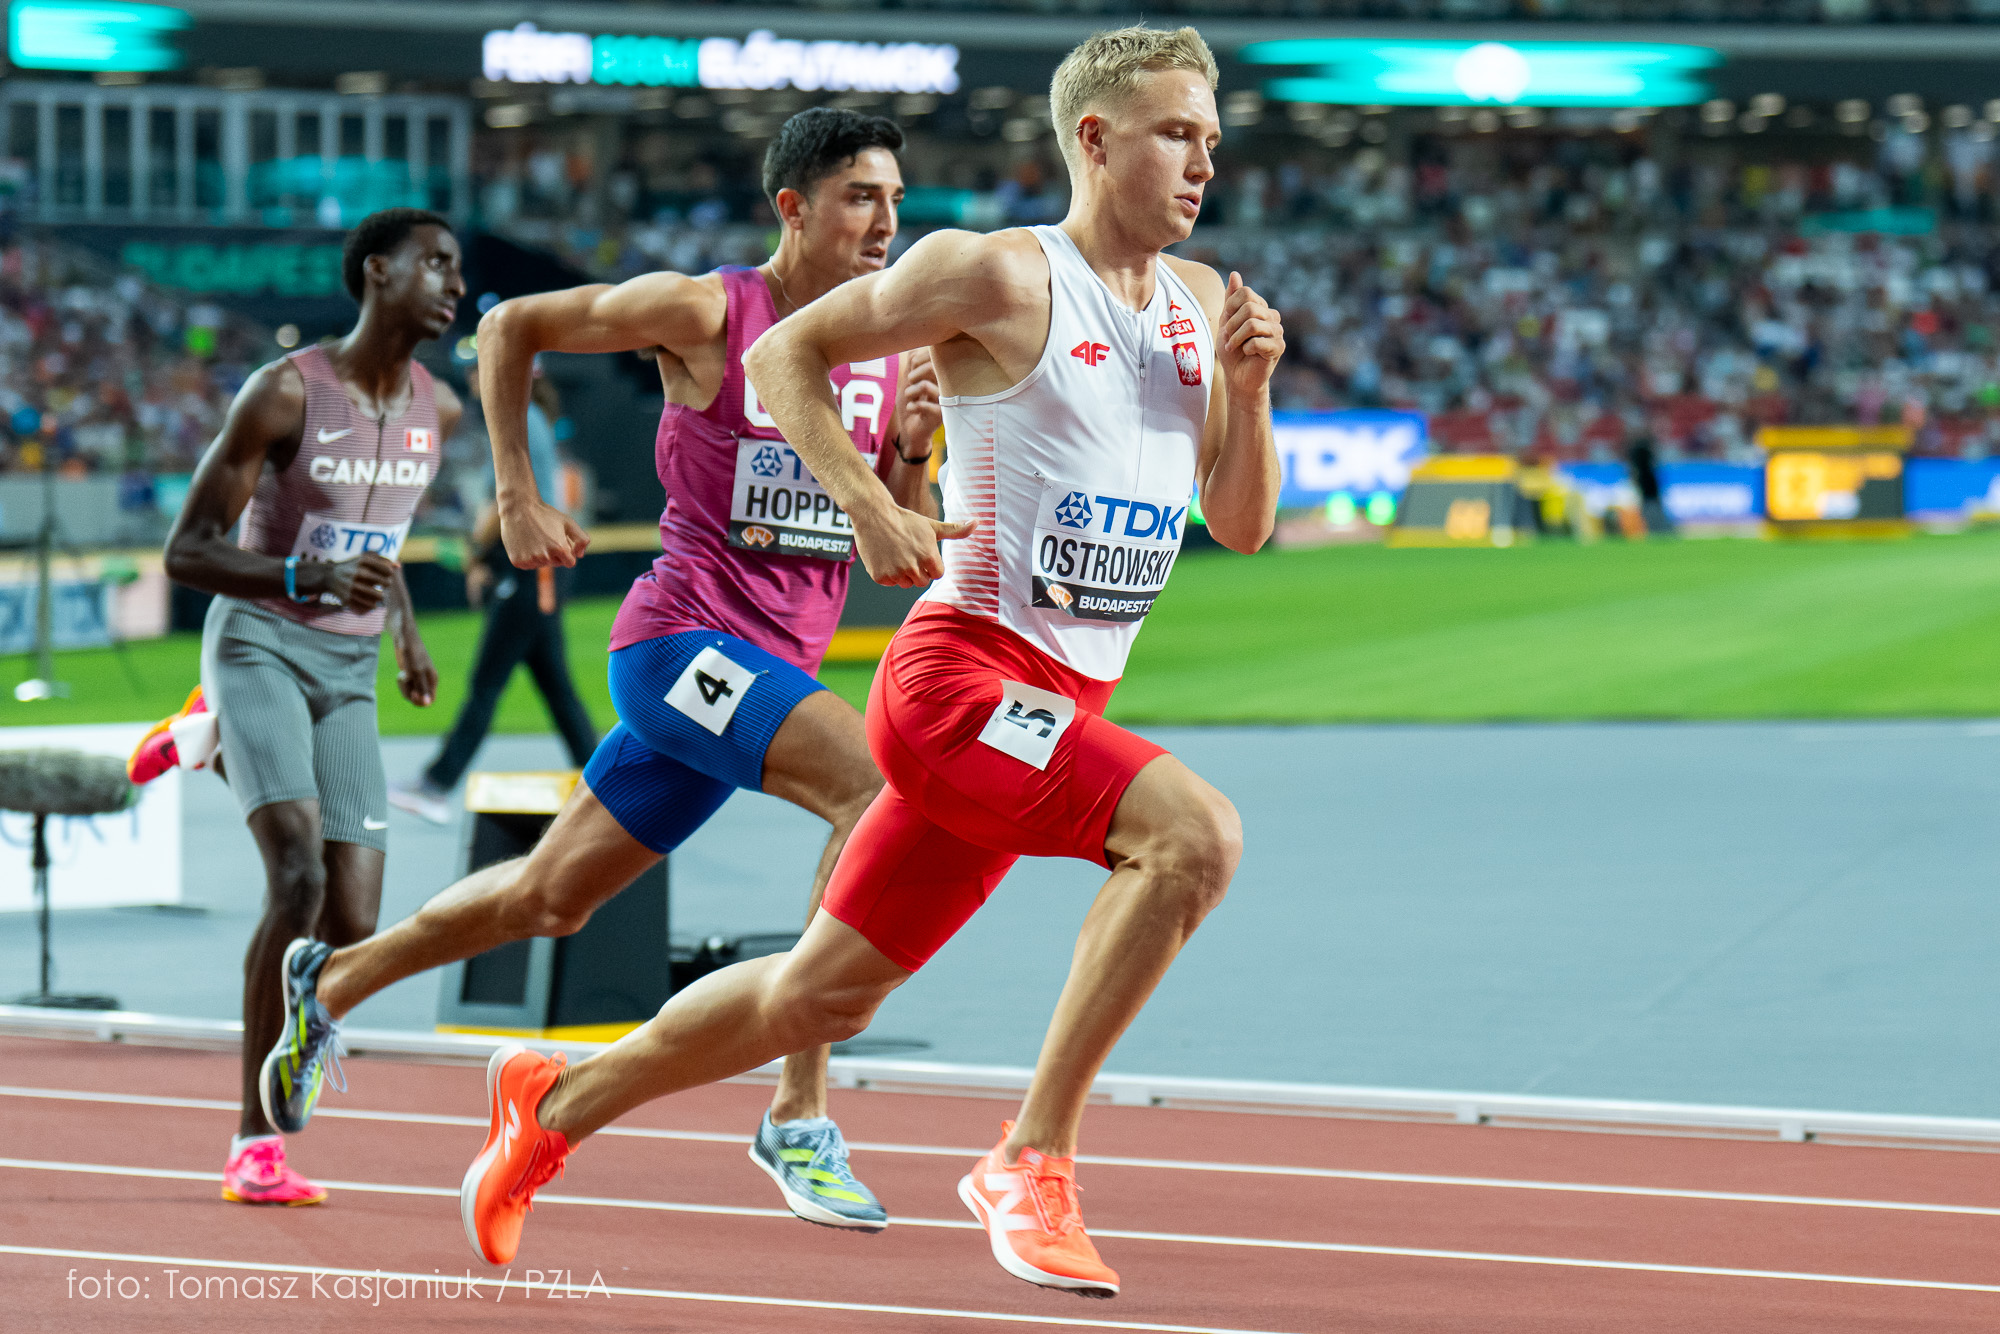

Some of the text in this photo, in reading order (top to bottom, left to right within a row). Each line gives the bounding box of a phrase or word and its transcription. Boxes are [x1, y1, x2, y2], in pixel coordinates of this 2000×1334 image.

[1162, 321, 1193, 337] OREN
[1071, 340, 1110, 367] 4F
[309, 456, 430, 486] CANADA
[745, 485, 853, 529] HOPPE
[1095, 495, 1186, 541] TDK
[1040, 534, 1175, 587] OSTROWSKI
[694, 668, 734, 707] 4
[1003, 699, 1056, 739] 5
